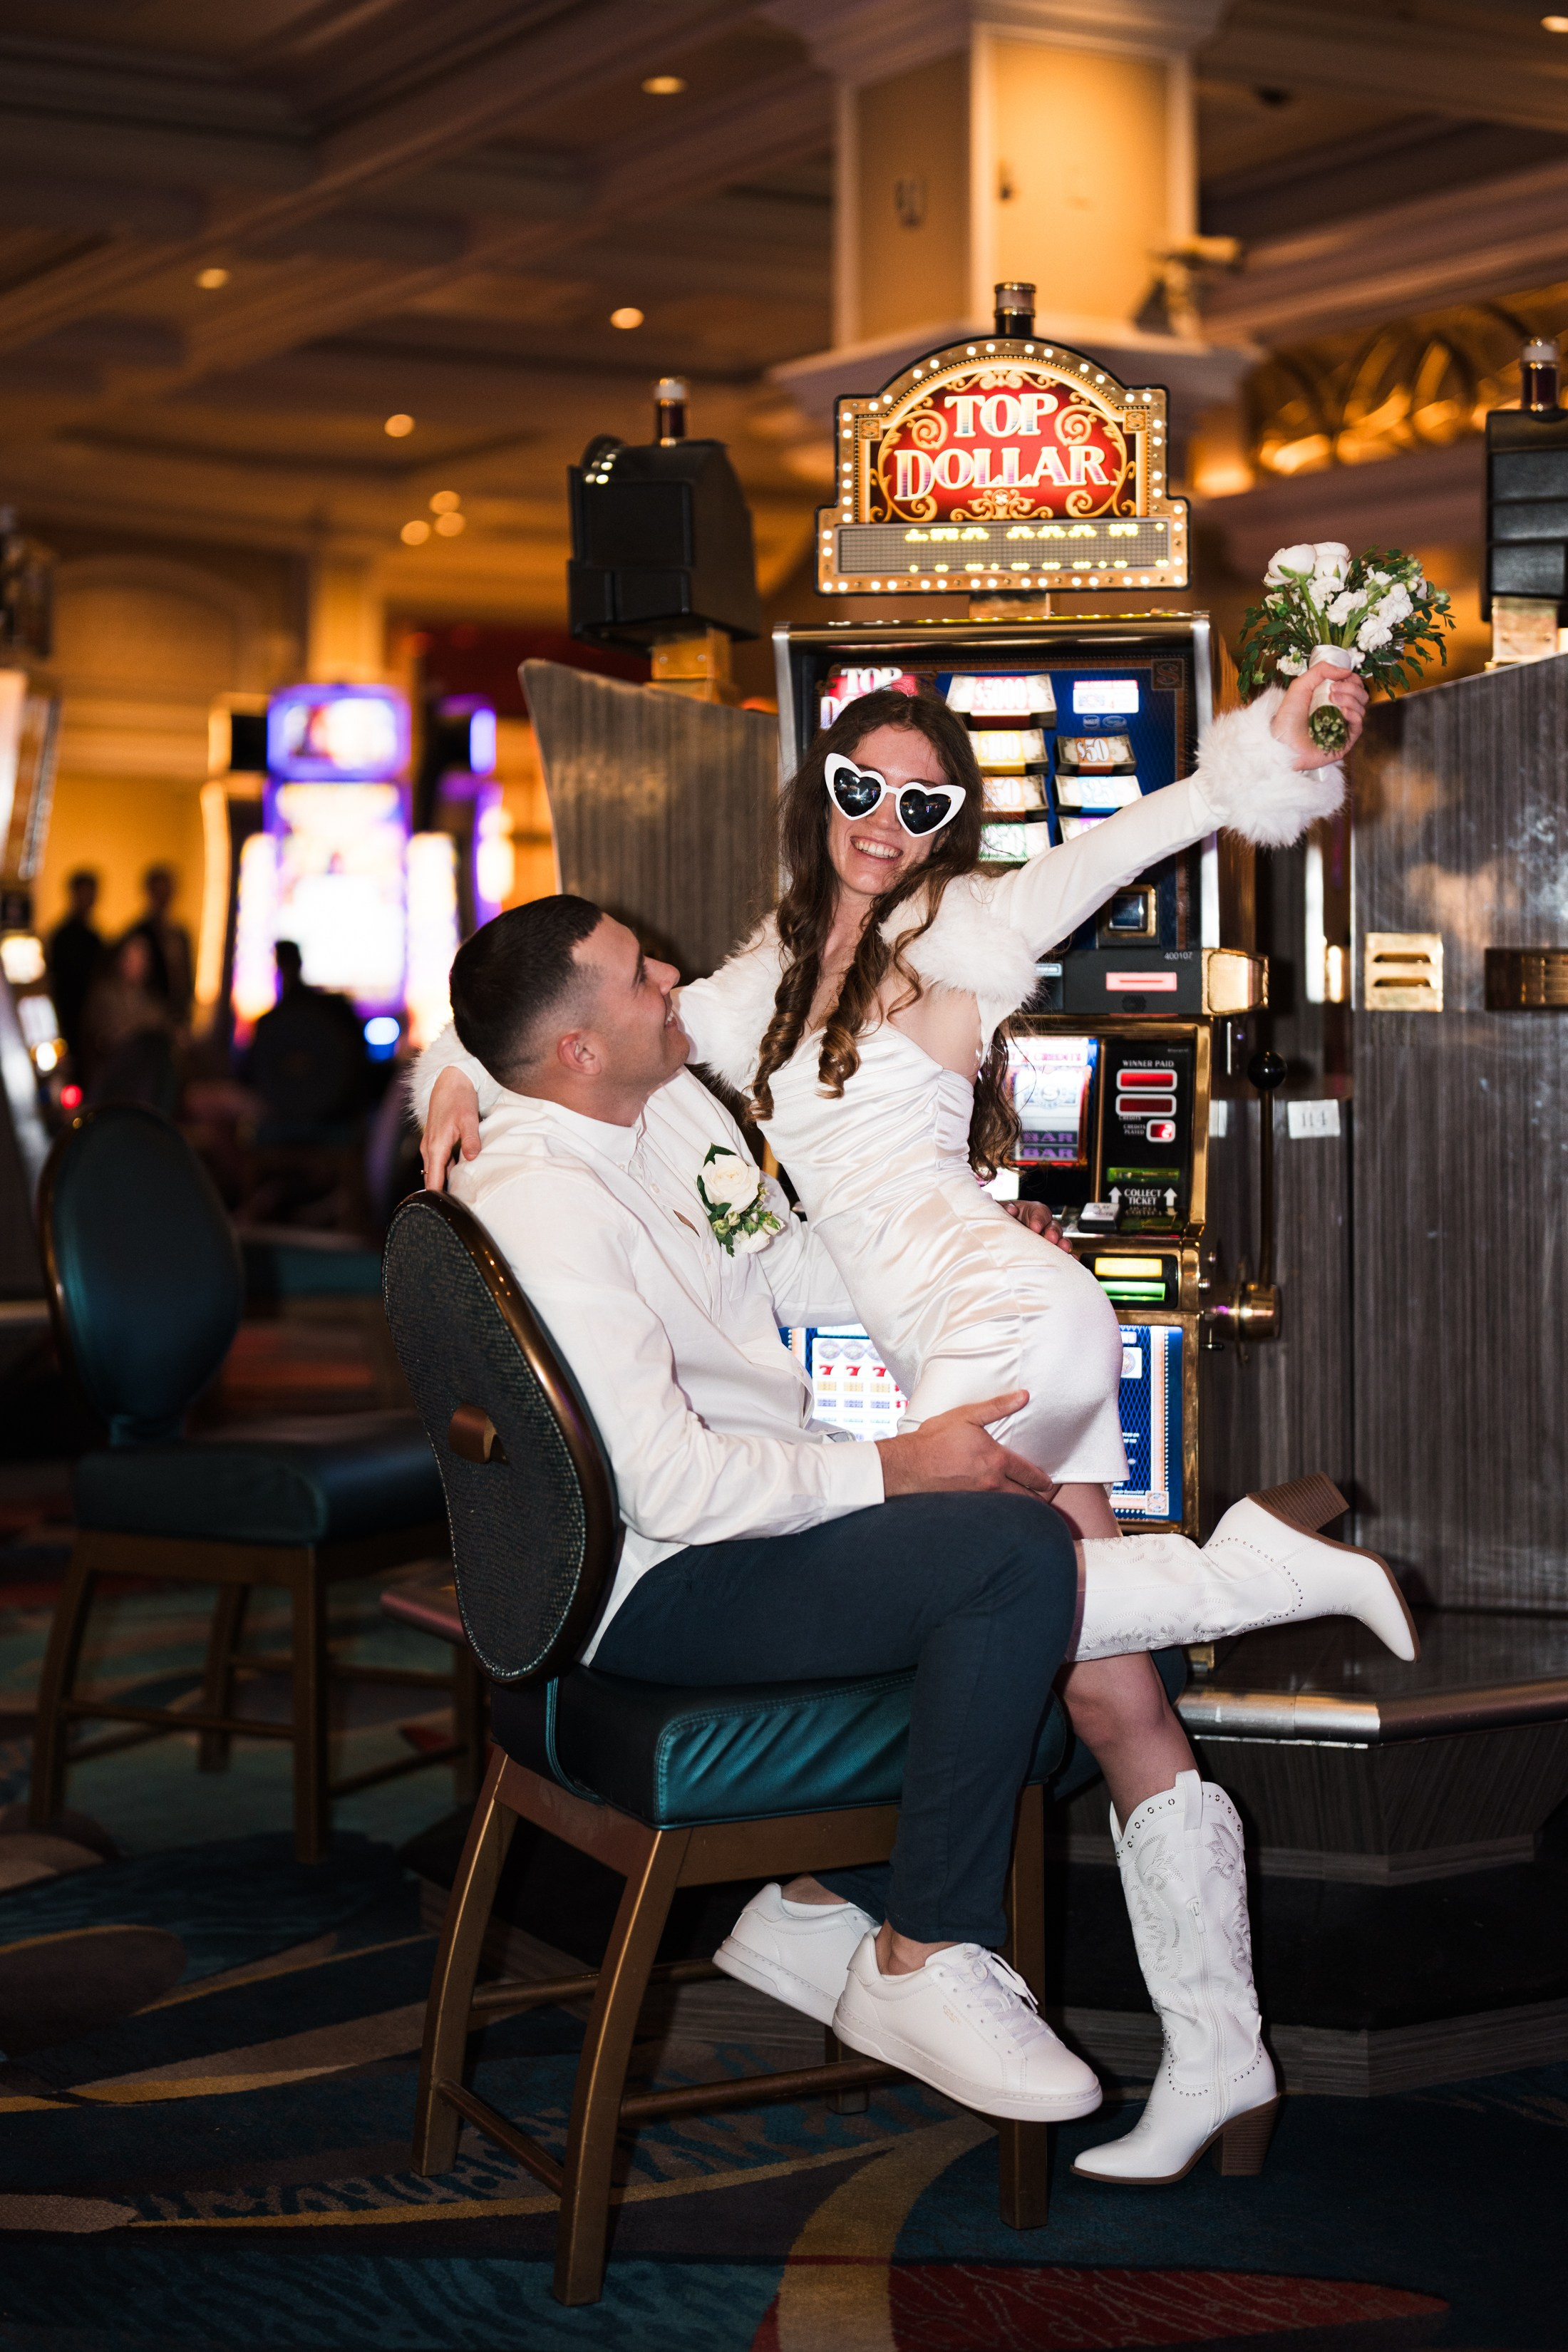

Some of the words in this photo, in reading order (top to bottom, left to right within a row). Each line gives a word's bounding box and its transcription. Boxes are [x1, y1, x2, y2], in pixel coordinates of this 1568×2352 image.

[944, 393, 1059, 438] TOP
[892, 445, 1110, 501] DOLLAR
[840, 666, 903, 695] TOP
[1076, 738, 1110, 763] $50
[1081, 778, 1115, 804] $25
[1164, 951, 1193, 961] 400107
[1122, 1059, 1153, 1068] WINNER
[1155, 1059, 1175, 1068] PAID
[1022, 1133, 1073, 1143] BAR
[1023, 1148, 1074, 1158] BAR
[1123, 1188, 1162, 1197] COLLECT
[1128, 1197, 1157, 1205] TICKET
